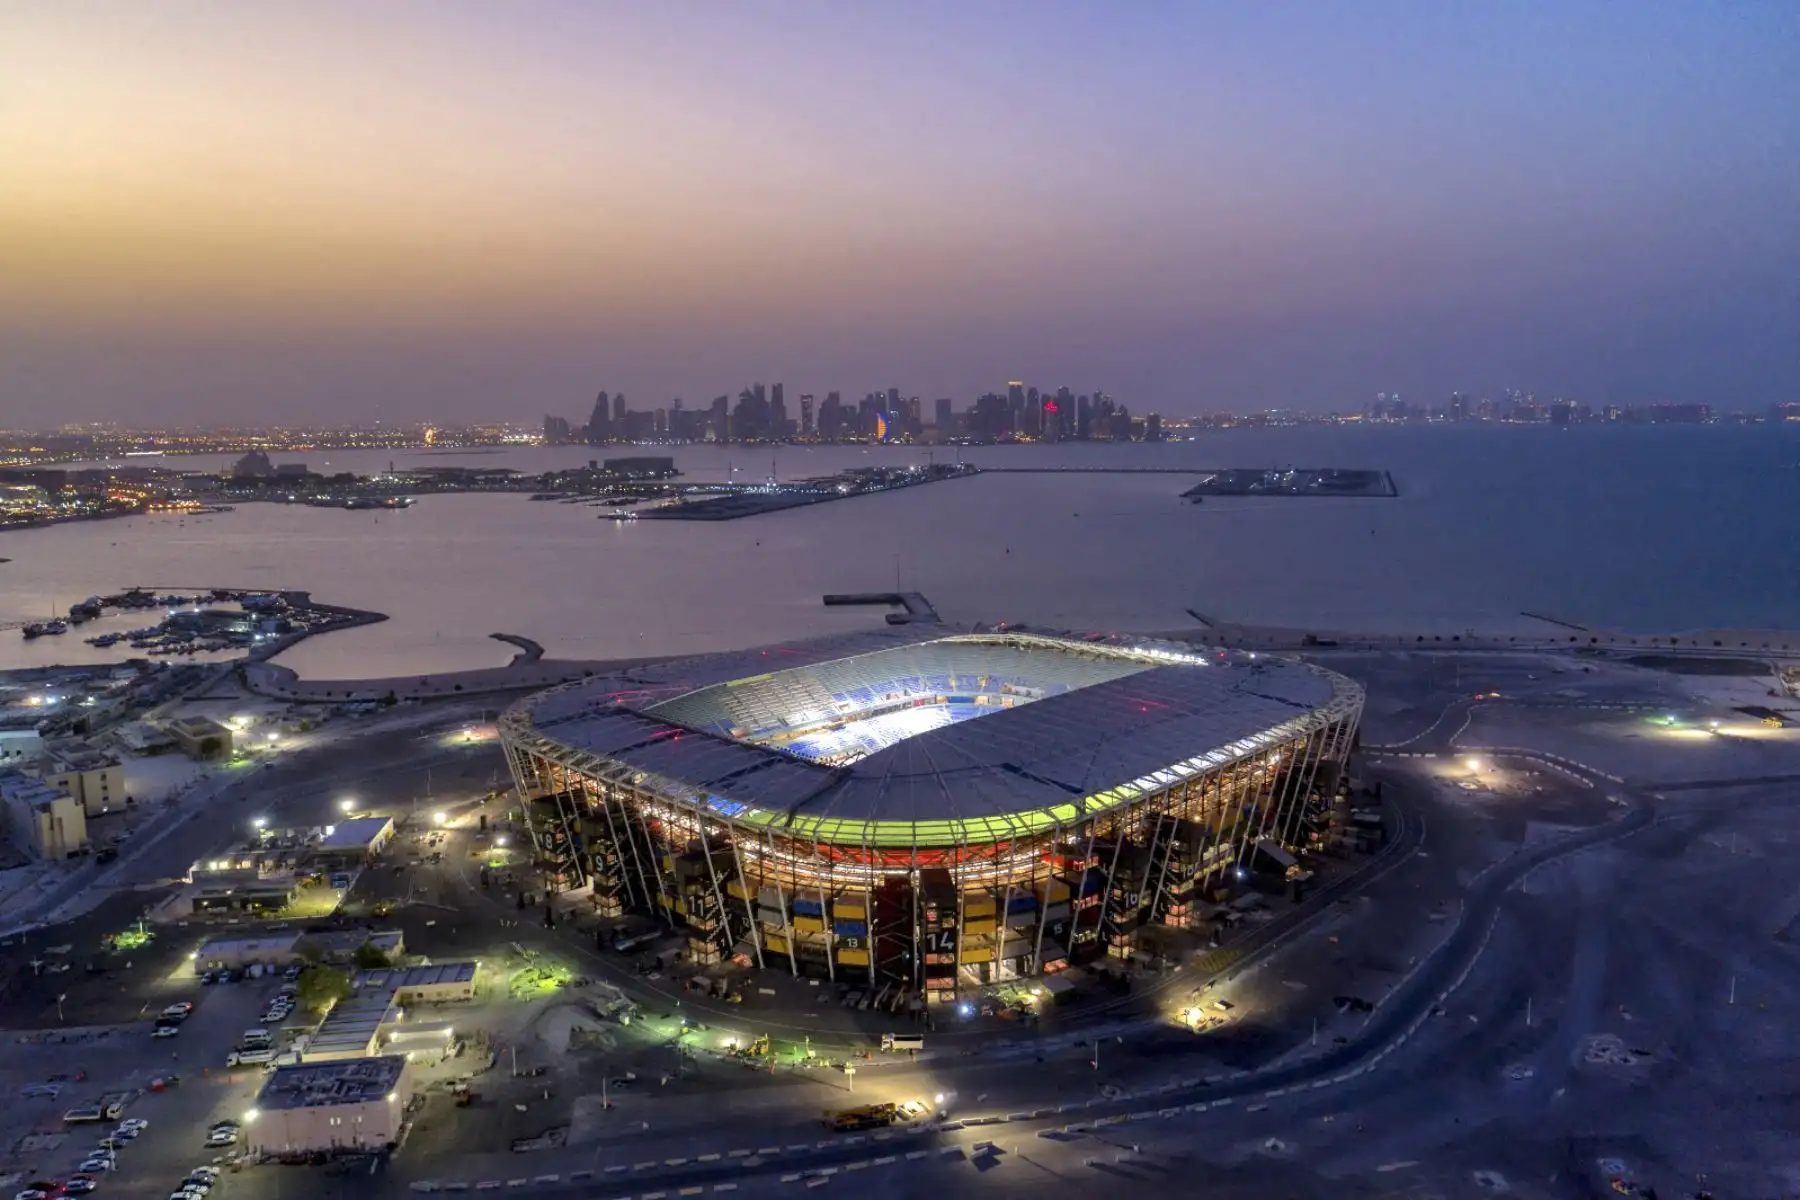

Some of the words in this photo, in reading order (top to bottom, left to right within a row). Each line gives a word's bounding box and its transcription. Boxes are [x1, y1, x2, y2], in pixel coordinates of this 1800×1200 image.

[596, 855, 604, 872] 9
[689, 896, 704, 917] 11
[846, 938, 858, 948] 13
[927, 931, 954, 951] 14
